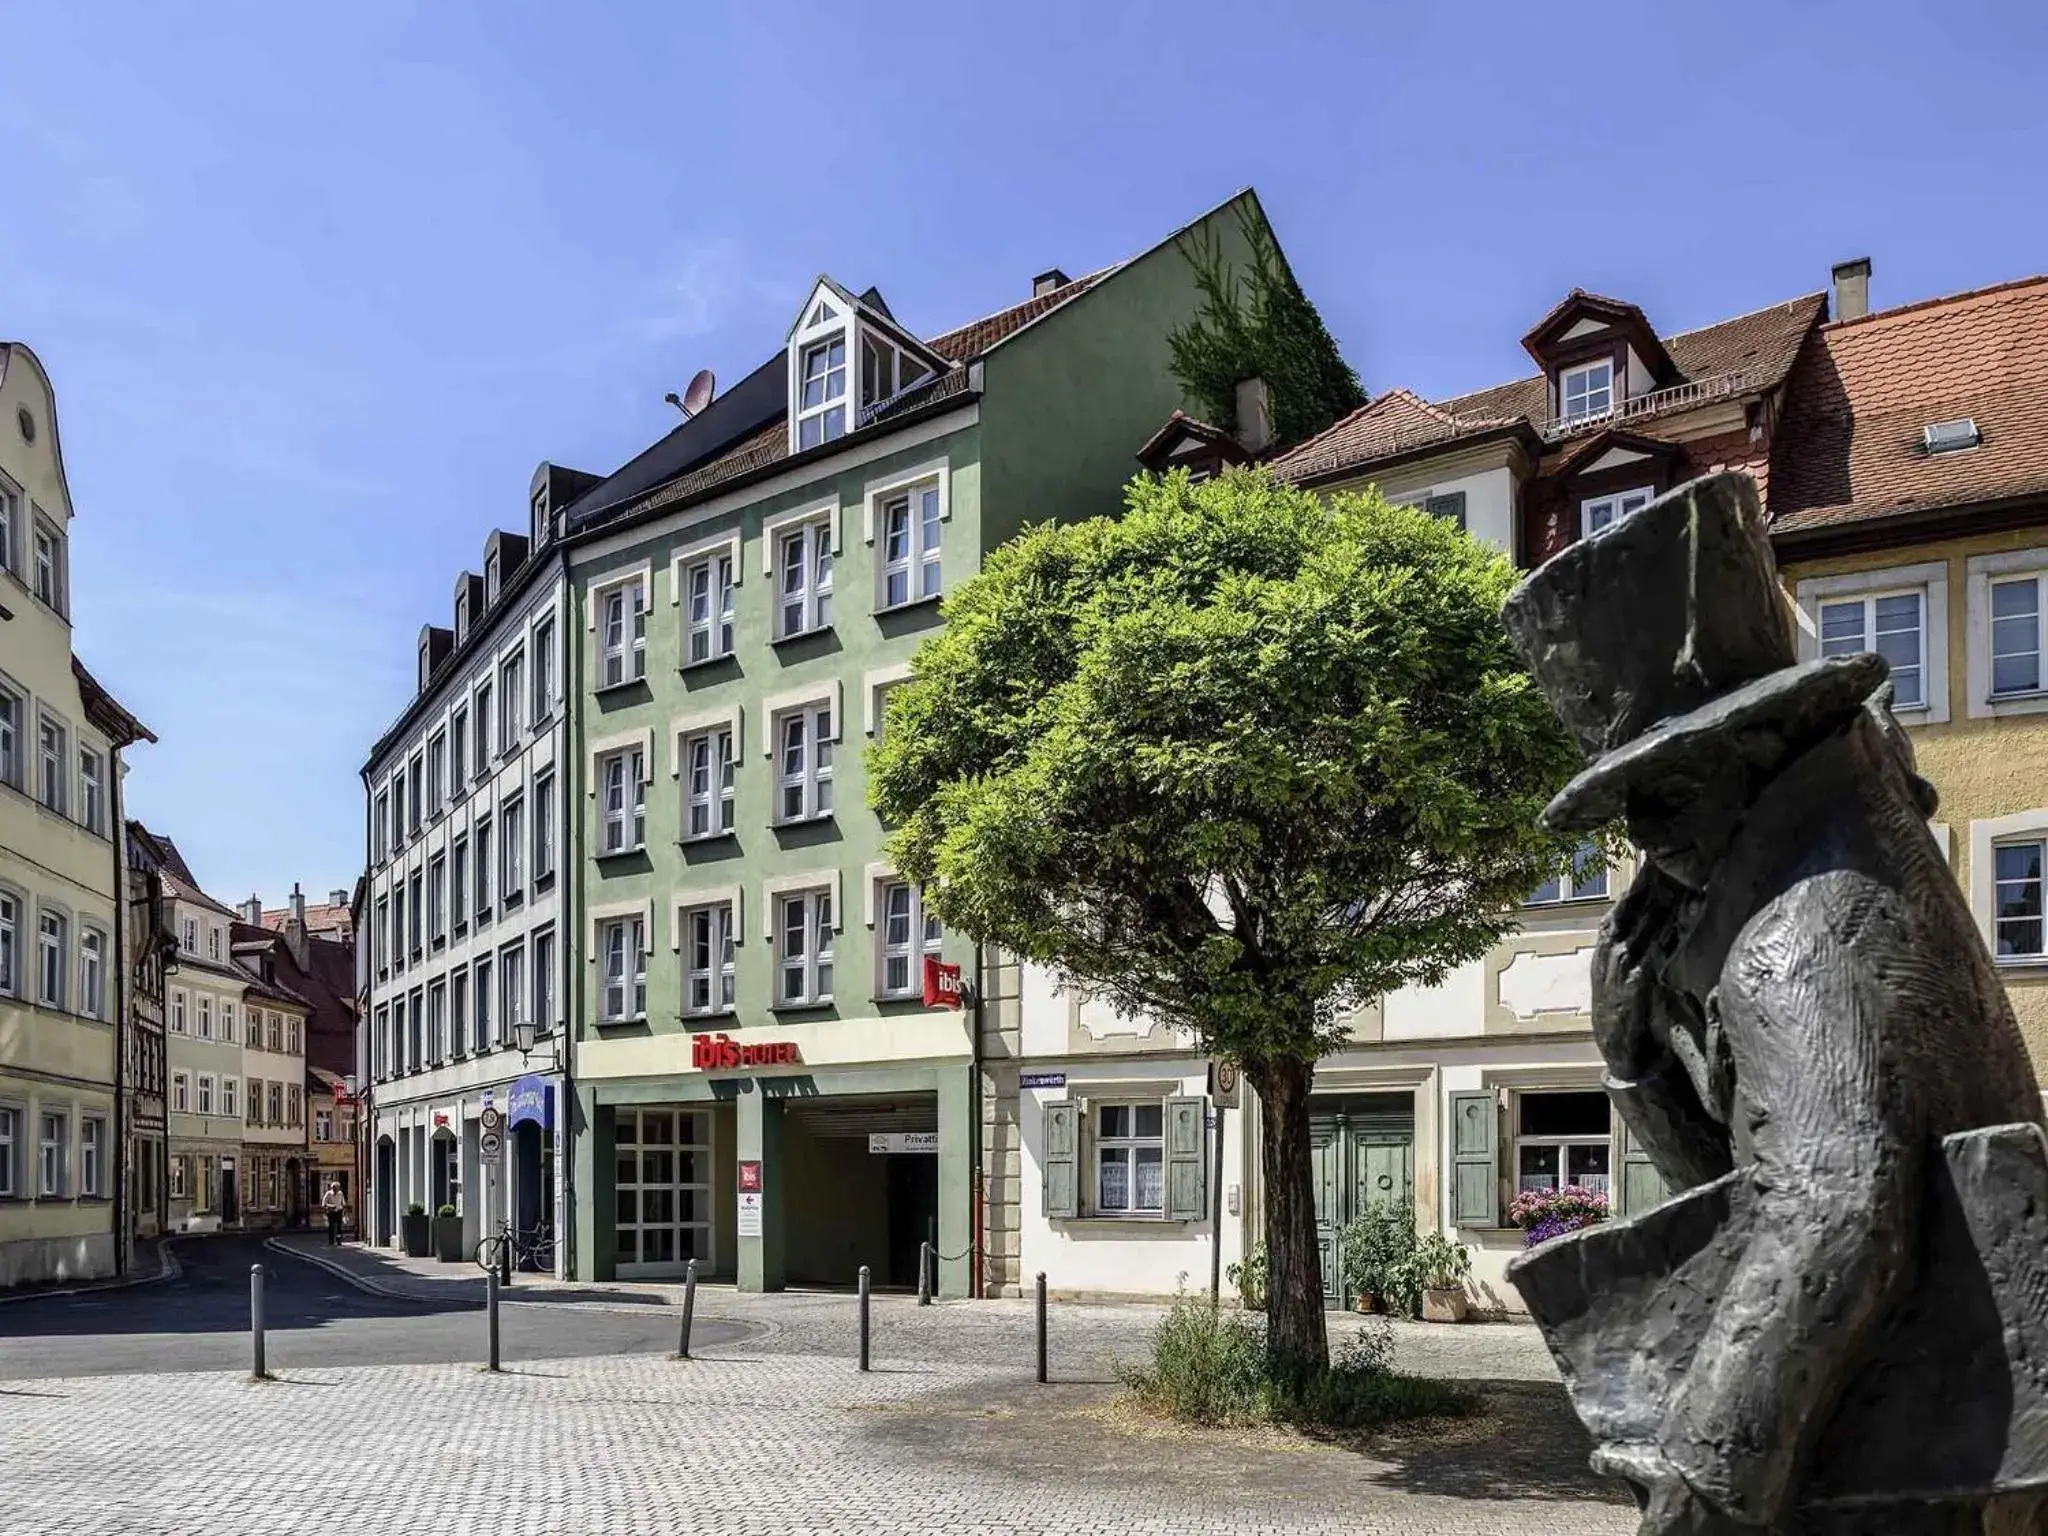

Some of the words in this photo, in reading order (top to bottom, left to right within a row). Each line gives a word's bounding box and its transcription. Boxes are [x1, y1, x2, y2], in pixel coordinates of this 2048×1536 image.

[939, 971, 962, 994] ibis
[692, 1033, 740, 1069] ibis
[1221, 1067, 1234, 1084] 30
